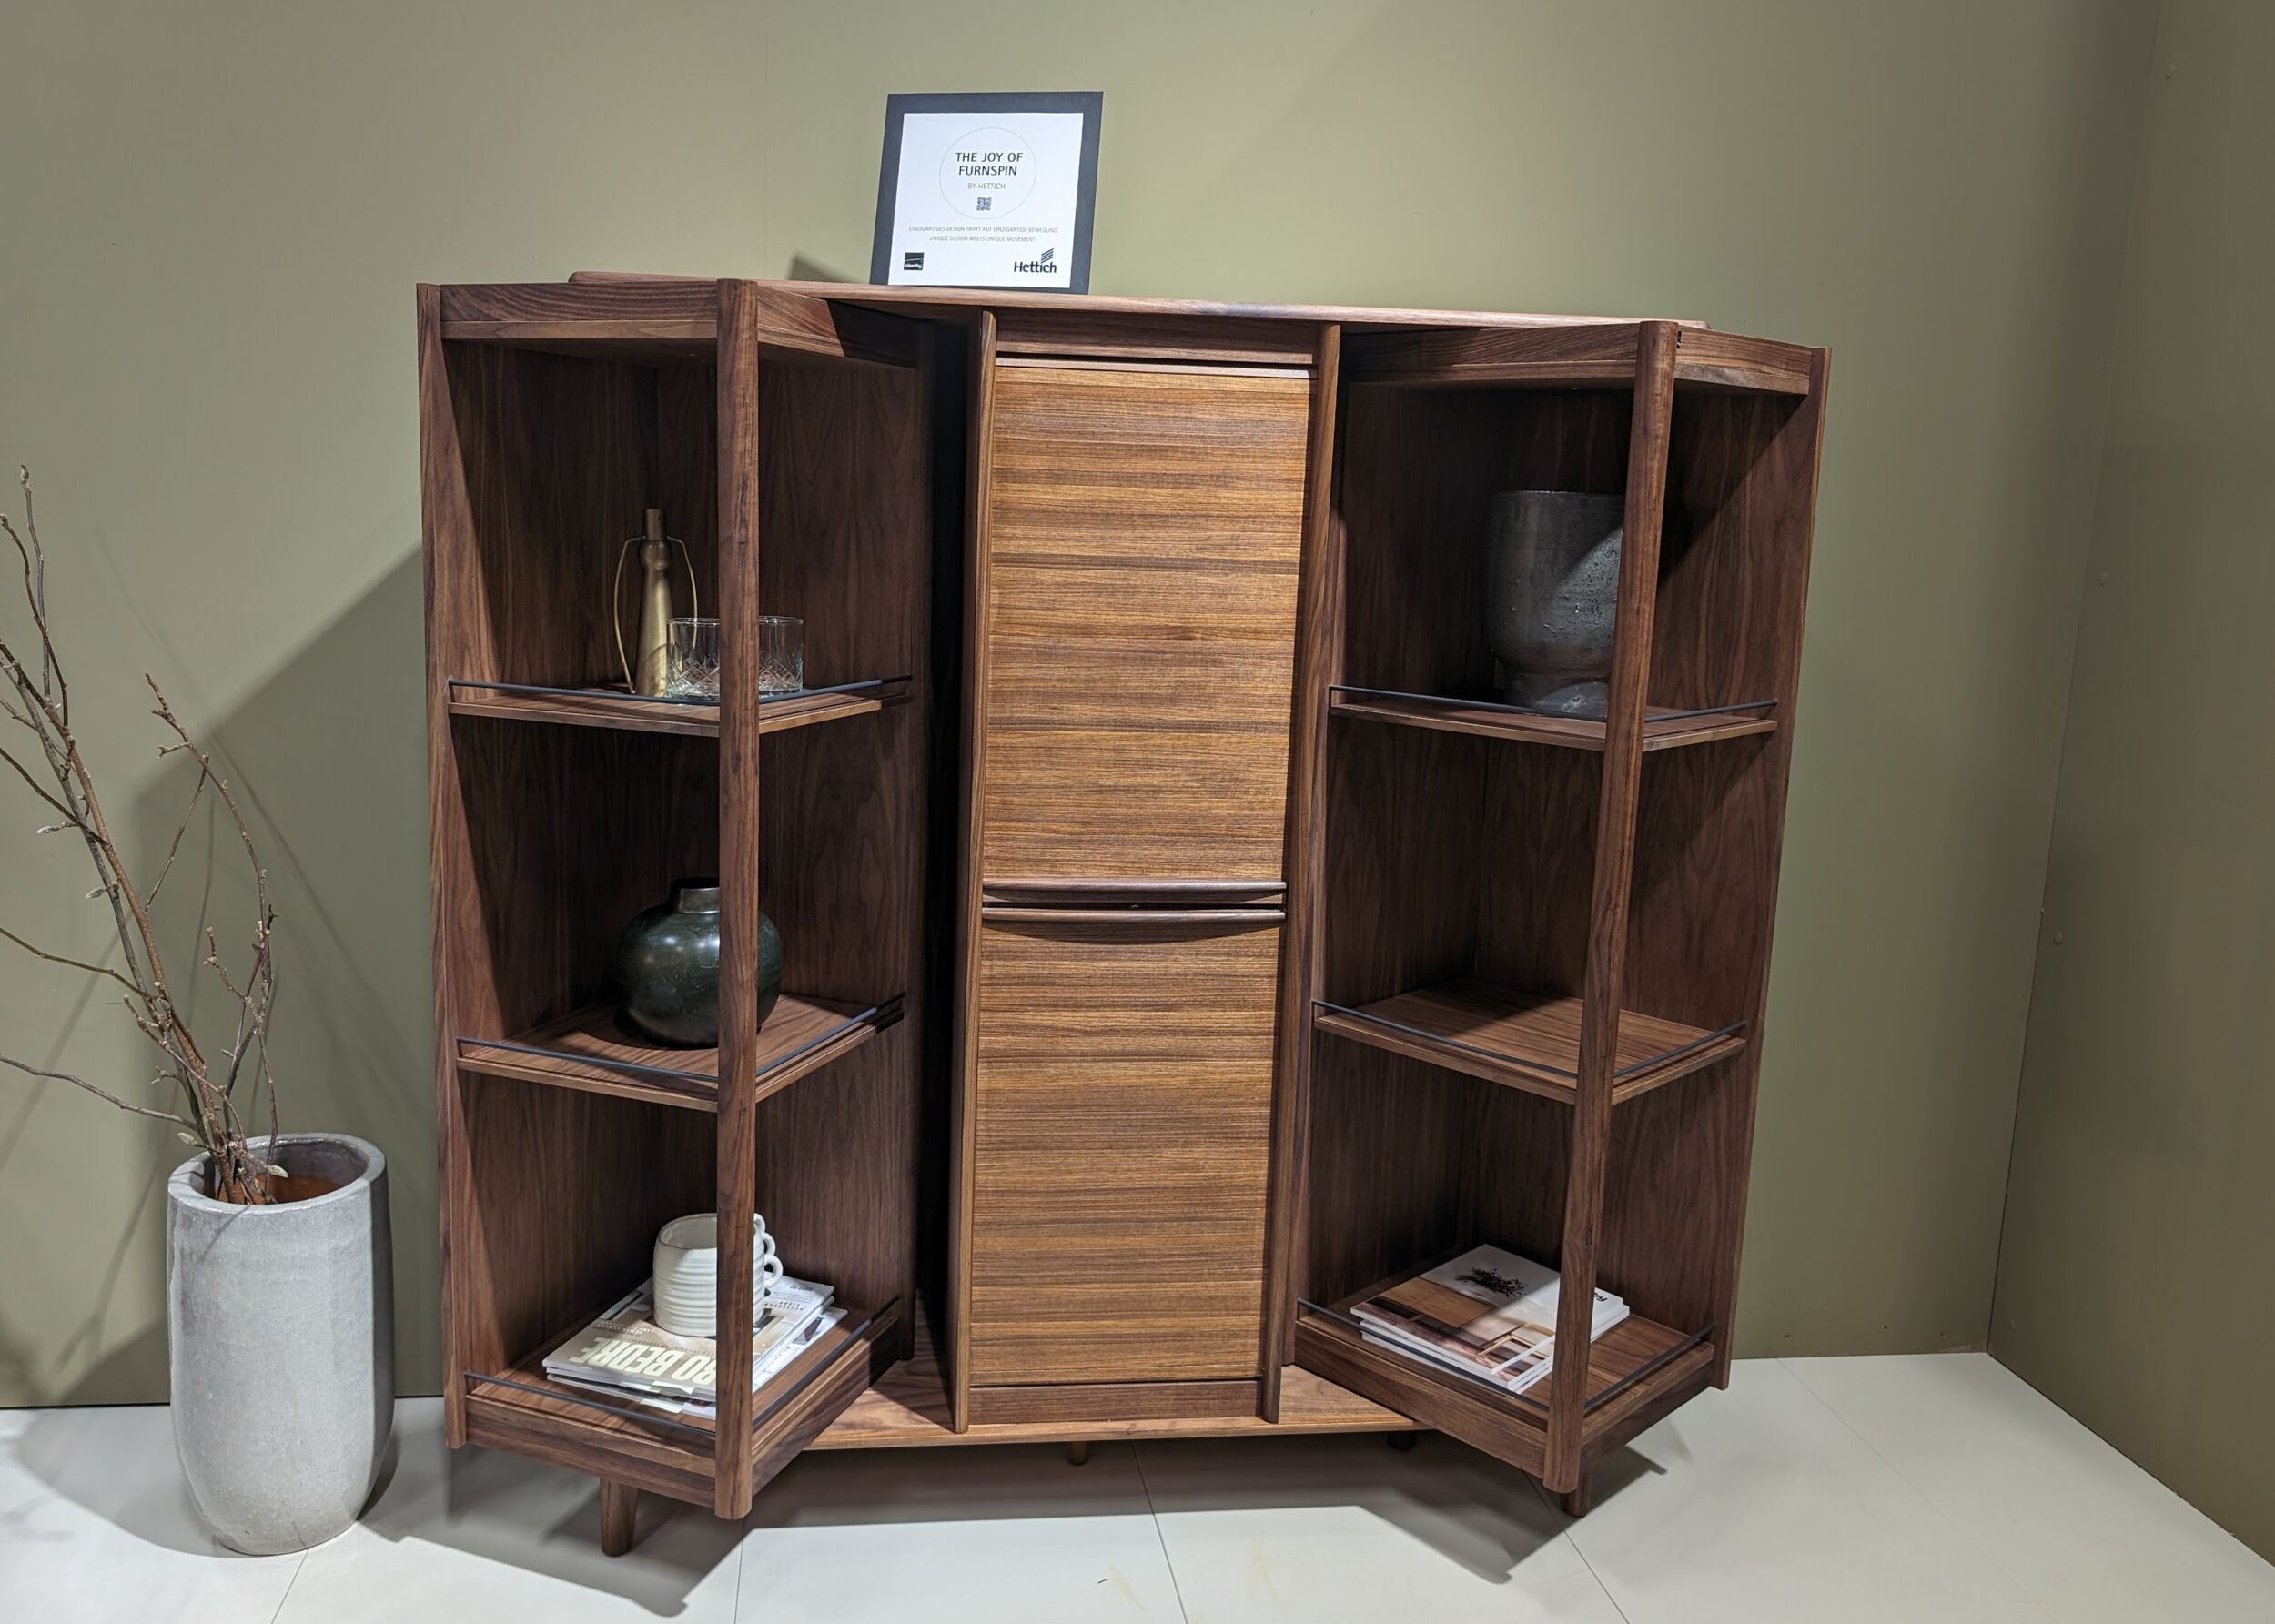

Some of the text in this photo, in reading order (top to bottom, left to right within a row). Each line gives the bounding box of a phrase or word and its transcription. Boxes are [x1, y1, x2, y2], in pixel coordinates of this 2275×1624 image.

[956, 152, 1024, 162] THE JOY OF
[958, 166, 1017, 176] FURNSPIN
[1014, 260, 1057, 273] Hettich
[569, 1337, 685, 1377] BEDRE
